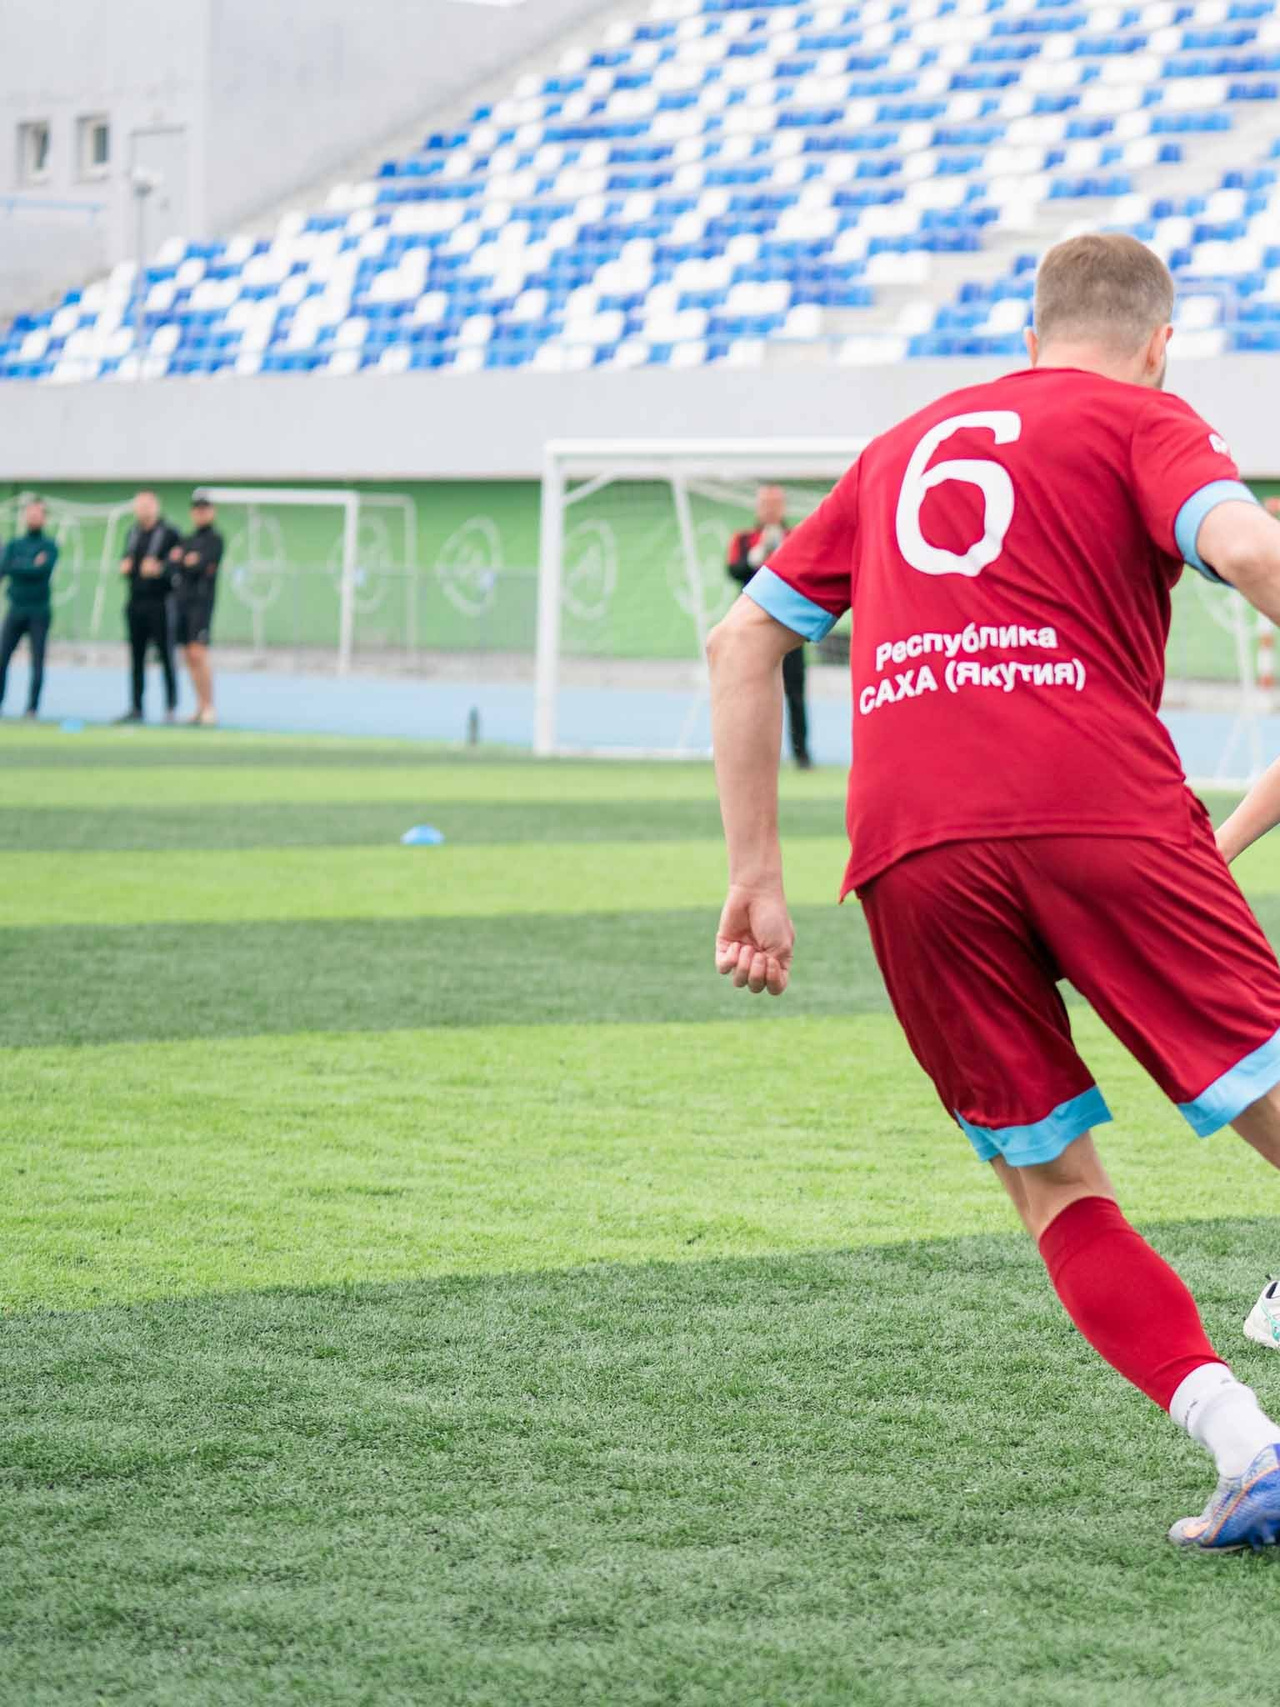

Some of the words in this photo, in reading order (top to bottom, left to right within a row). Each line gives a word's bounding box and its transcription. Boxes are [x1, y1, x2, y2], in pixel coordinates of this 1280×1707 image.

[895, 409, 1022, 577] 6
[875, 621, 1059, 672] Республика
[859, 664, 938, 715] САХА
[944, 658, 1087, 692] (Якутия)
